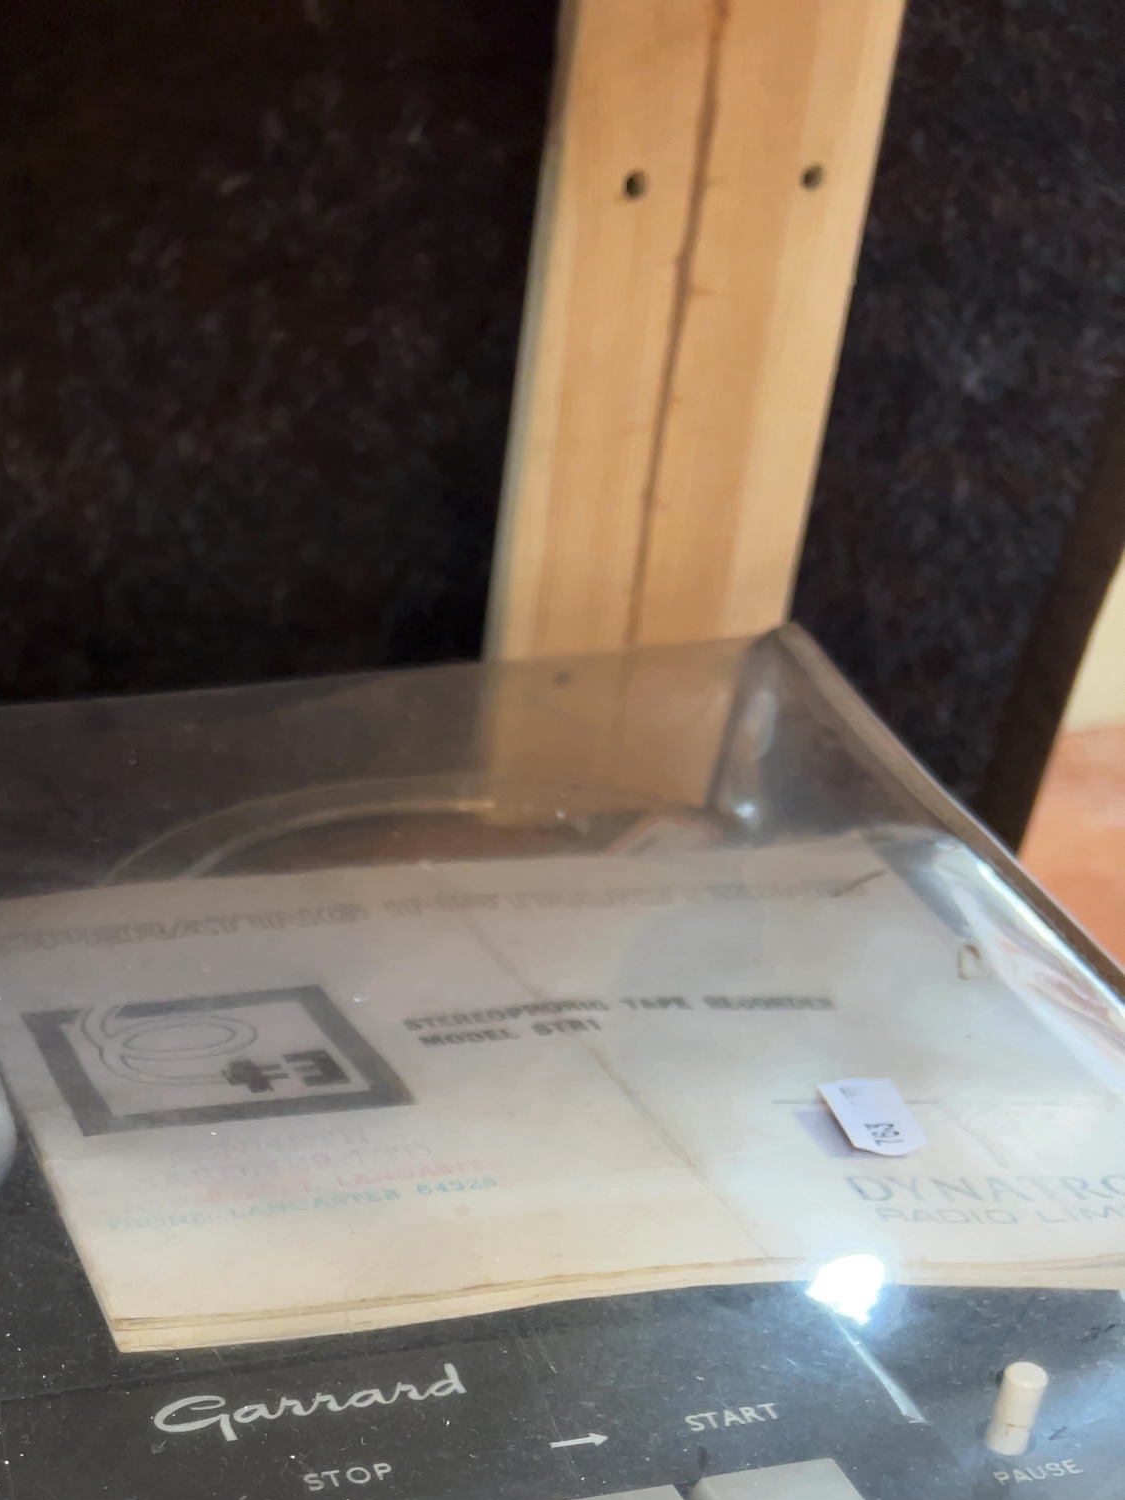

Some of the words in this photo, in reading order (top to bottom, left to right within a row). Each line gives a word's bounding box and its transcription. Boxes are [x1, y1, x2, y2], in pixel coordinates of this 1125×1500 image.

[403, 1000, 611, 1031] STEREOPHONIC
[620, 995, 692, 1011] TAPE
[418, 1027, 520, 1048] MODEL
[875, 1207, 1019, 1225] RADIO
[154, 1363, 466, 1441] Garrard
[684, 1403, 779, 1432] START
[303, 1462, 392, 1491] STOP
[993, 1459, 1084, 1486] PAUSE
